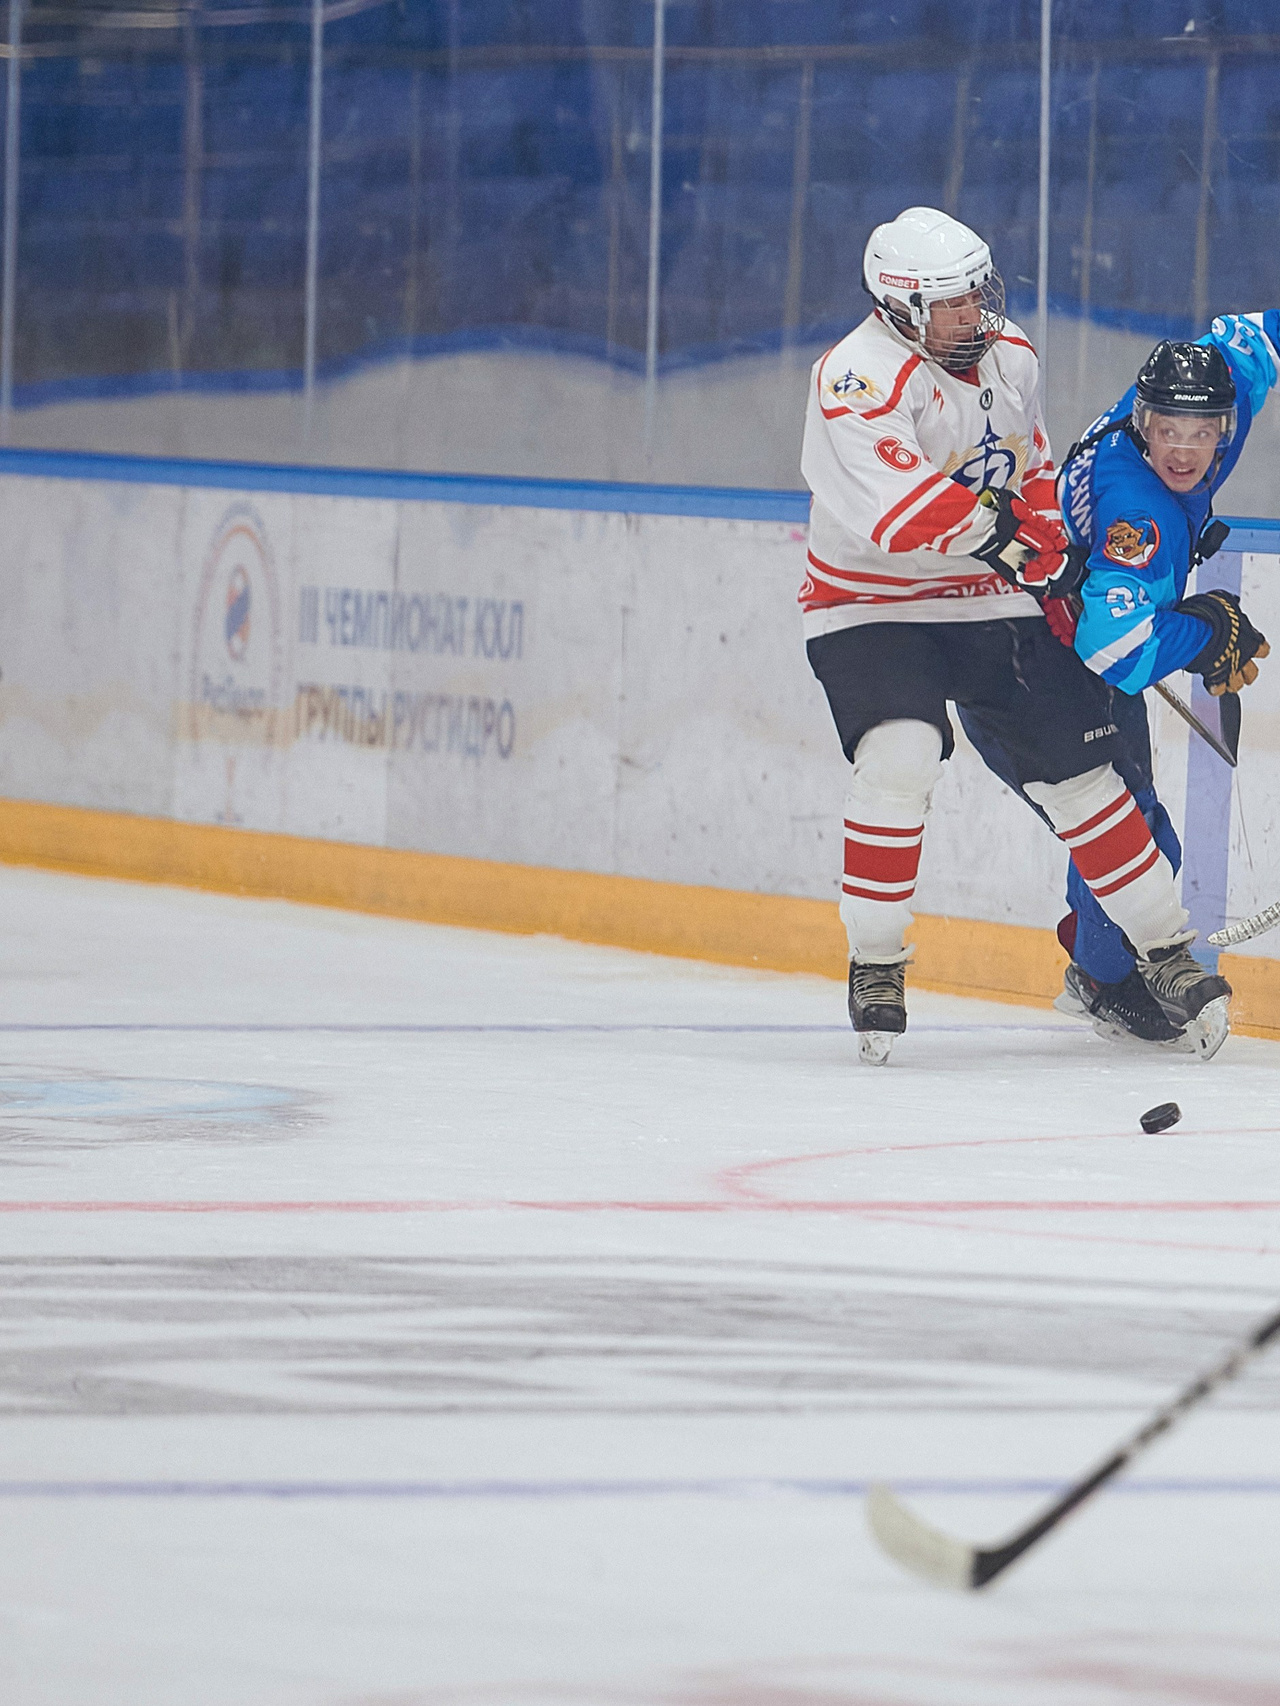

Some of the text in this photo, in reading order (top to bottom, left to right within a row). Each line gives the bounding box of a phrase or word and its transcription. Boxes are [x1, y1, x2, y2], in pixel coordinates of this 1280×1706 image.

[880, 274, 917, 288] FONBET
[1174, 393, 1209, 402] BAUER
[873, 435, 921, 473] 6
[325, 586, 469, 656] ЧЕМПИОНАТ
